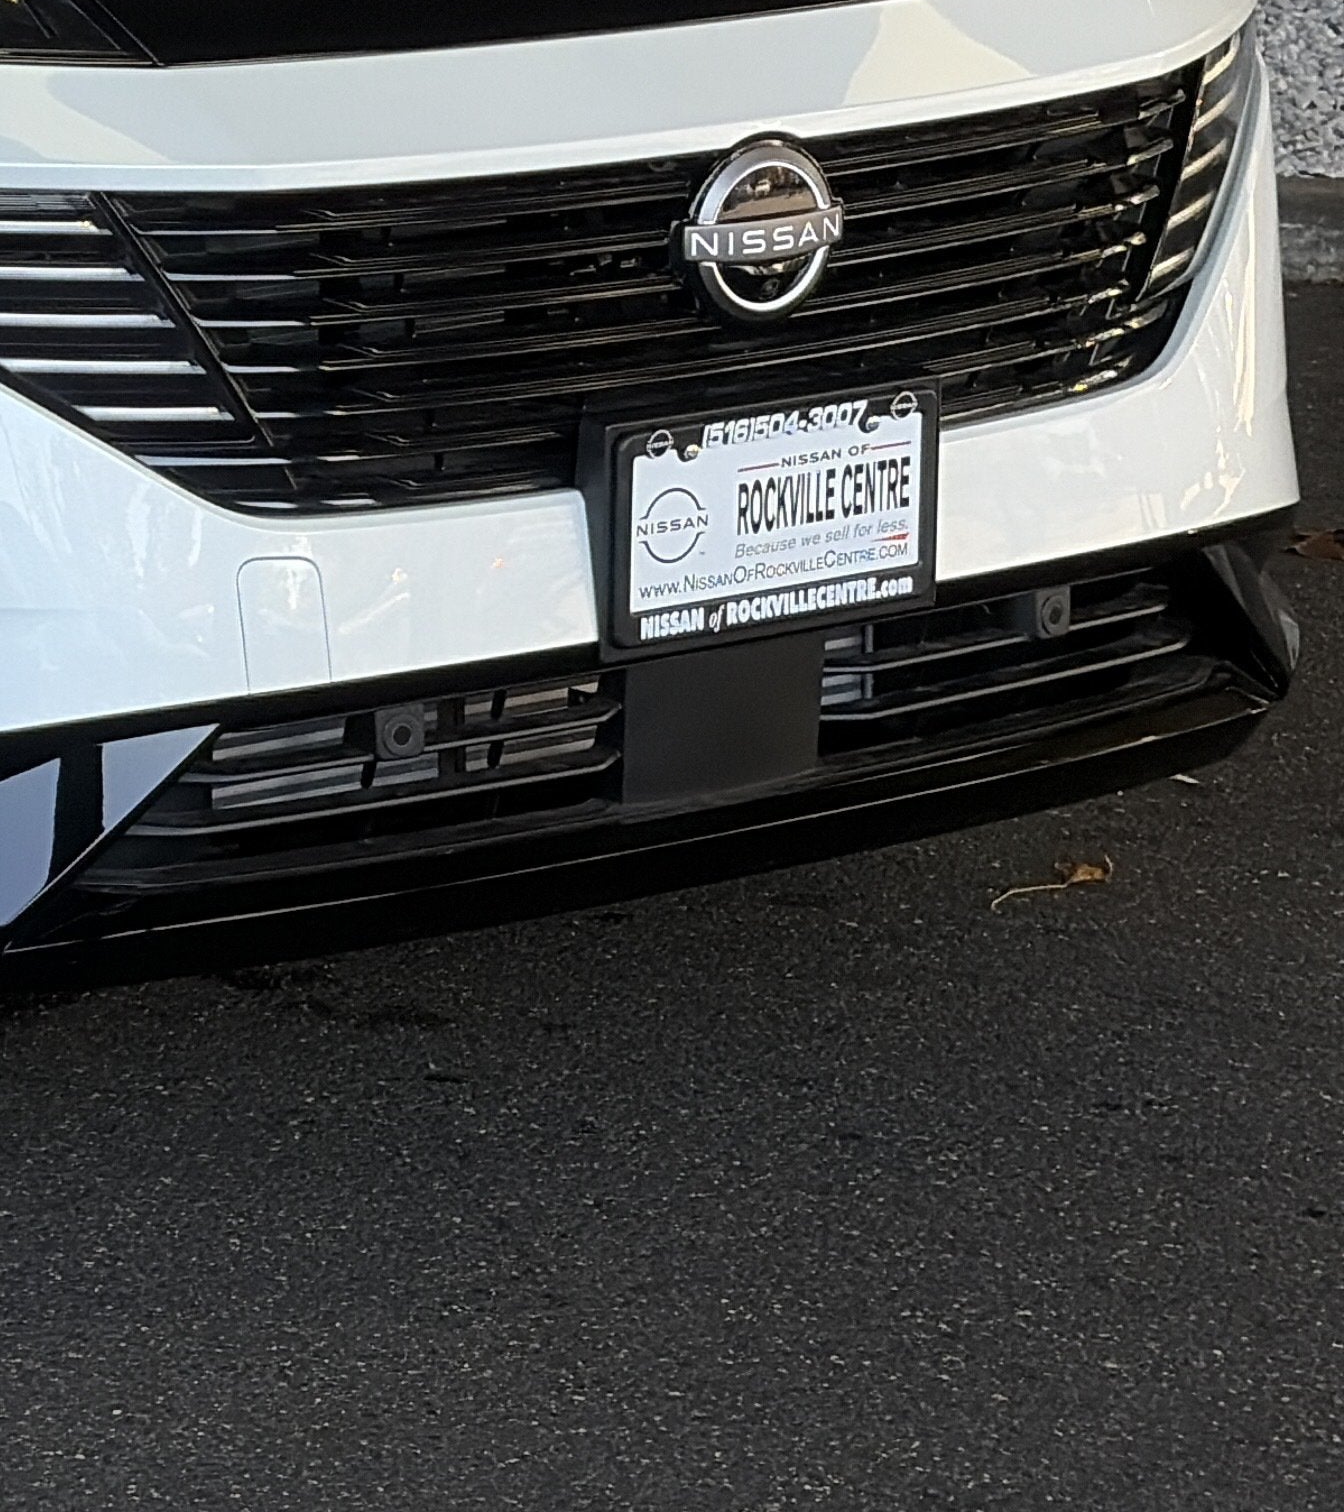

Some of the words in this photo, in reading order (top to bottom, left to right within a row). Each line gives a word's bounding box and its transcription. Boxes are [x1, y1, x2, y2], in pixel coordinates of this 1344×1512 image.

[690, 213, 840, 257] NISSAN
[780, 448, 842, 468] NISSAN
[848, 443, 871, 457] OF
[737, 468, 836, 536] ROCKVILLE
[840, 456, 911, 519] CENTRE
[636, 514, 709, 538] NISSAN
[734, 538, 797, 559] Because
[801, 533, 821, 546] we
[825, 526, 850, 543] sell
[853, 523, 872, 538] for
[640, 608, 705, 641] NISSAN
[708, 602, 725, 633] of
[726, 576, 914, 626] ROCKVILLECENTRE.com
